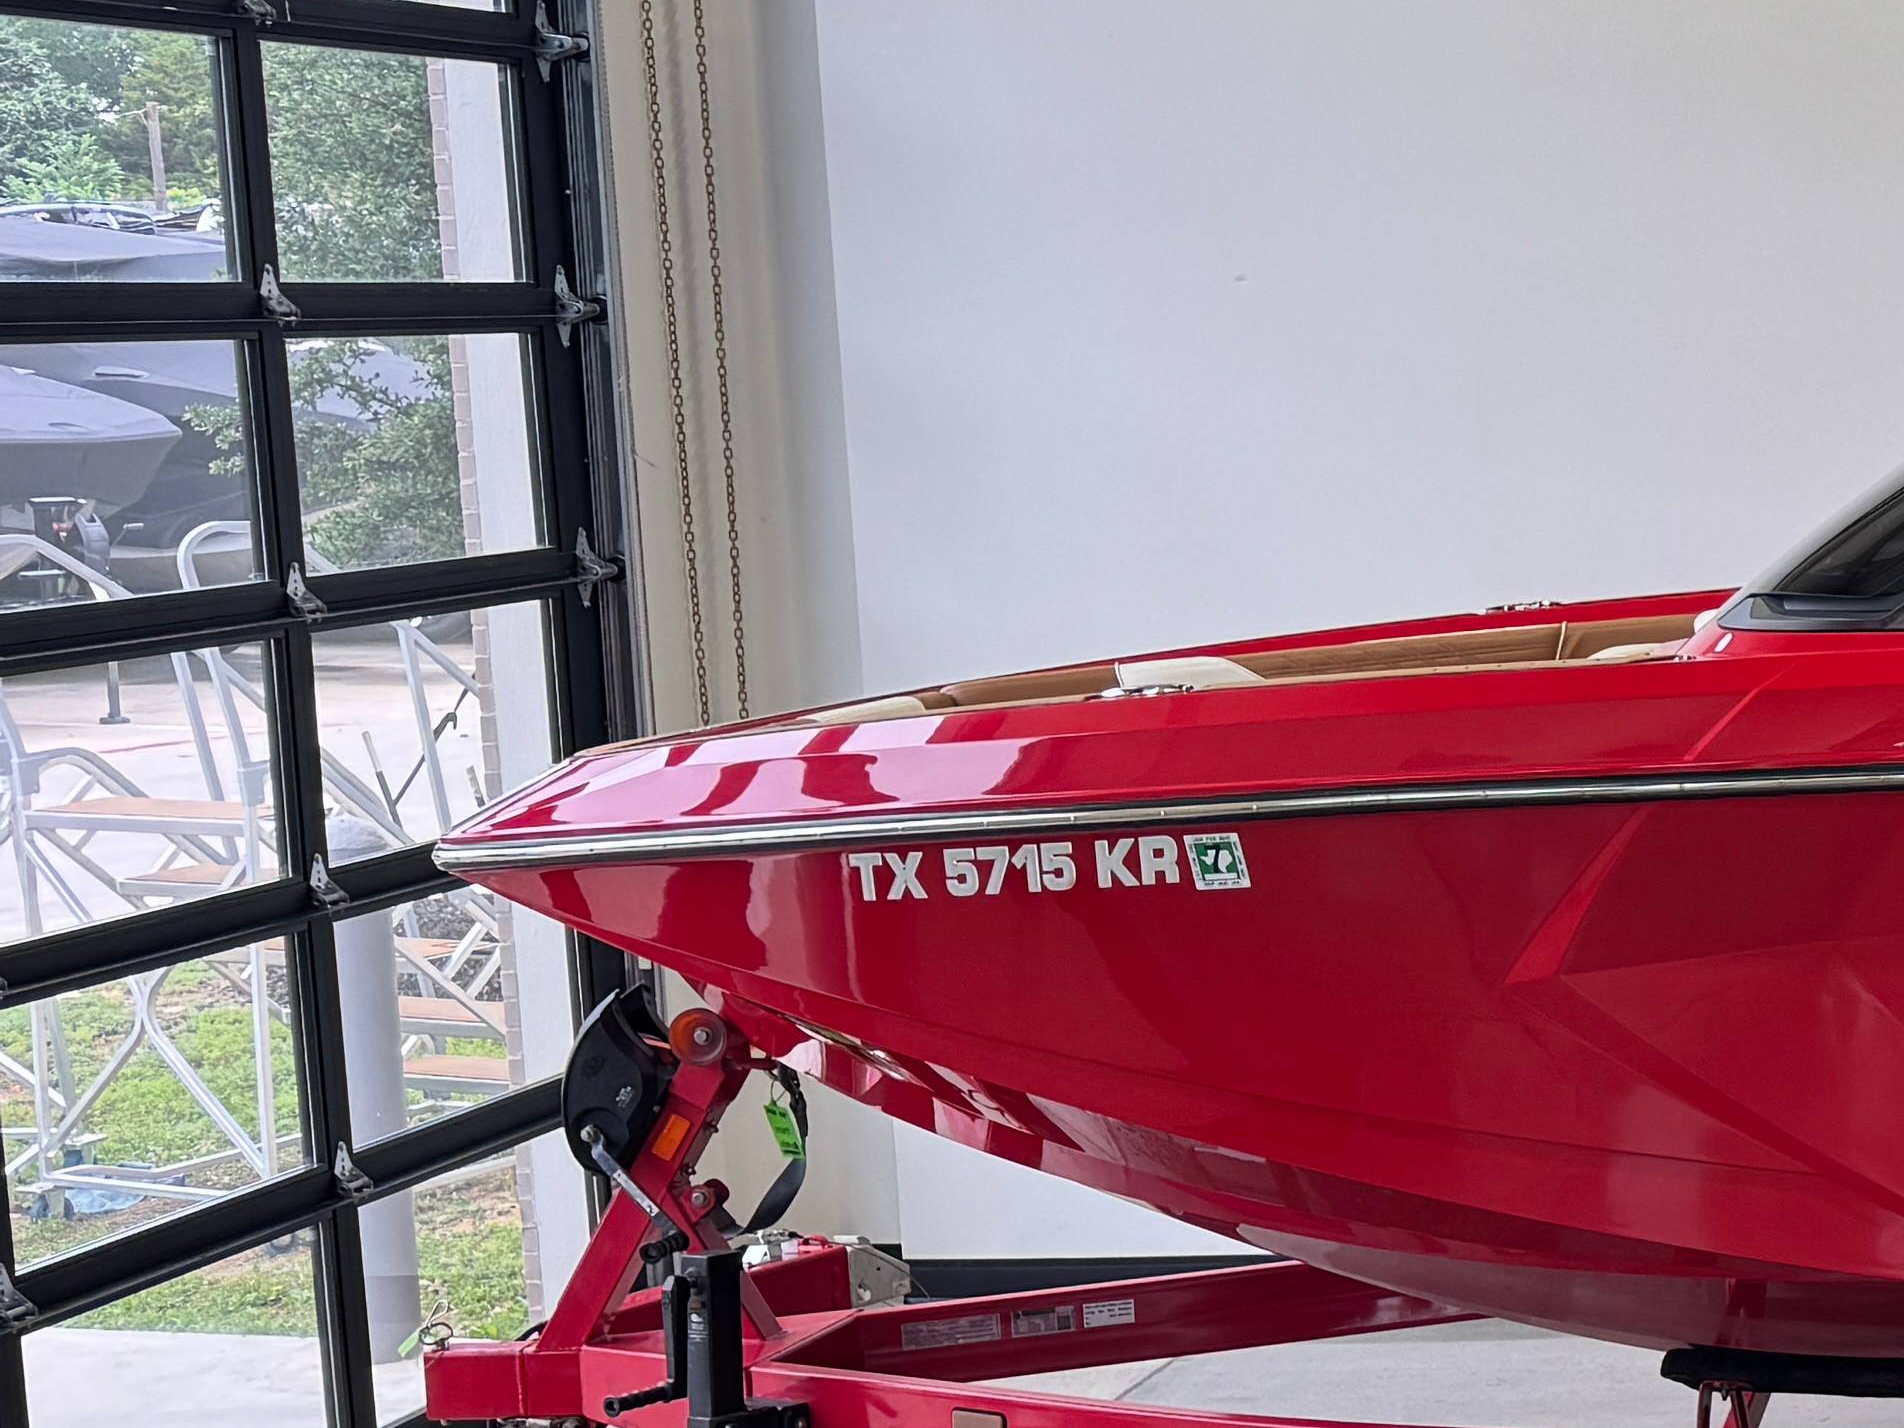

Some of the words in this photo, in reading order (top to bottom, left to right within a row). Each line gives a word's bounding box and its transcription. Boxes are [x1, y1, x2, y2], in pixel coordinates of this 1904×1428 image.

[848, 851, 928, 902] TX
[944, 841, 1075, 897] 5715
[1096, 835, 1180, 889] KR
